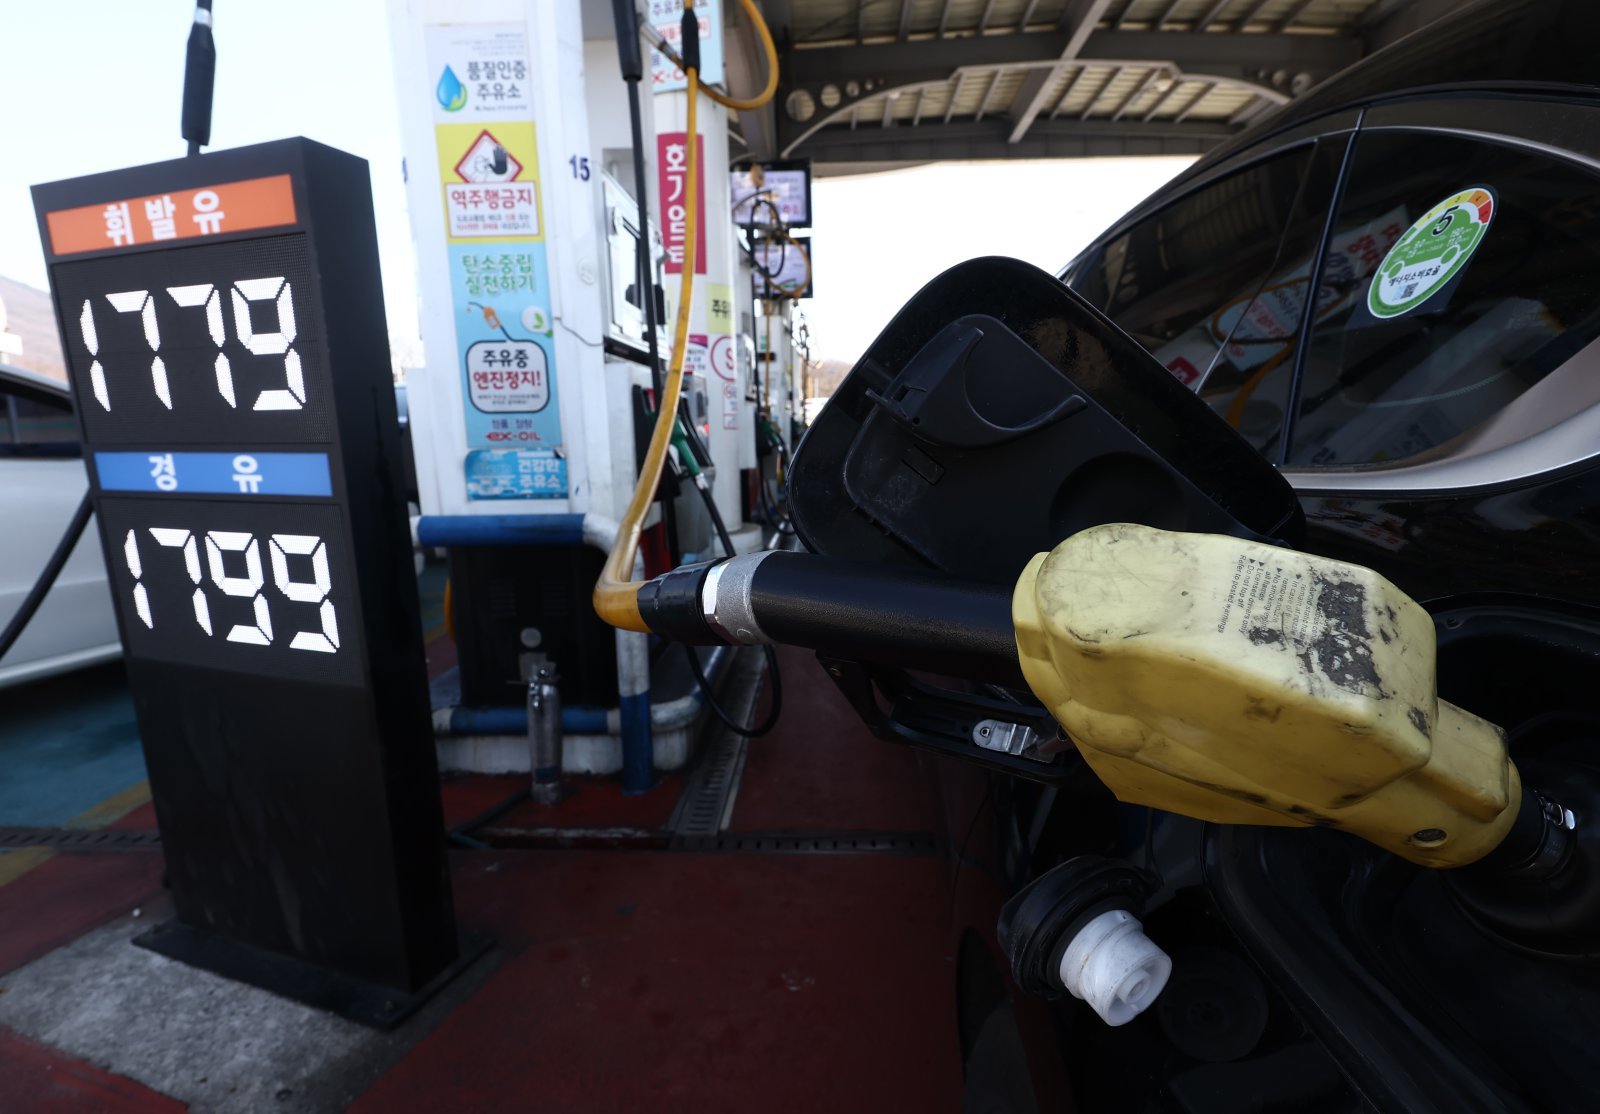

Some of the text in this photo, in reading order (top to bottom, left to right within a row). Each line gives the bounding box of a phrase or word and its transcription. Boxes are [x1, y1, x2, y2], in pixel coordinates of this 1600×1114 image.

[467, 60, 527, 81] 품질인증
[477, 83, 521, 101] 주유소
[569, 155, 590, 181] 15
[451, 188, 533, 210] 역주행금지
[103, 190, 225, 246] 휘발유
[1432, 204, 1459, 236] 5
[462, 254, 532, 275] 탄소중립
[465, 275, 535, 296] 실천하기
[79, 276, 306, 412] 1779
[482, 349, 529, 369] 주유중
[473, 371, 542, 390] 엔진정지!
[148, 453, 263, 493] 경유
[1237, 555, 1246, 572] Refer
[1247, 565, 1254, 574] Do
[1273, 574, 1281, 583] No
[1278, 578, 1288, 601] remove
[123, 526, 340, 654] 1799
[1228, 580, 1238, 603] posted
[1239, 587, 1247, 597] top
[1238, 568, 1264, 635] Licensed drivers only
[1218, 604, 1231, 633] warnings
